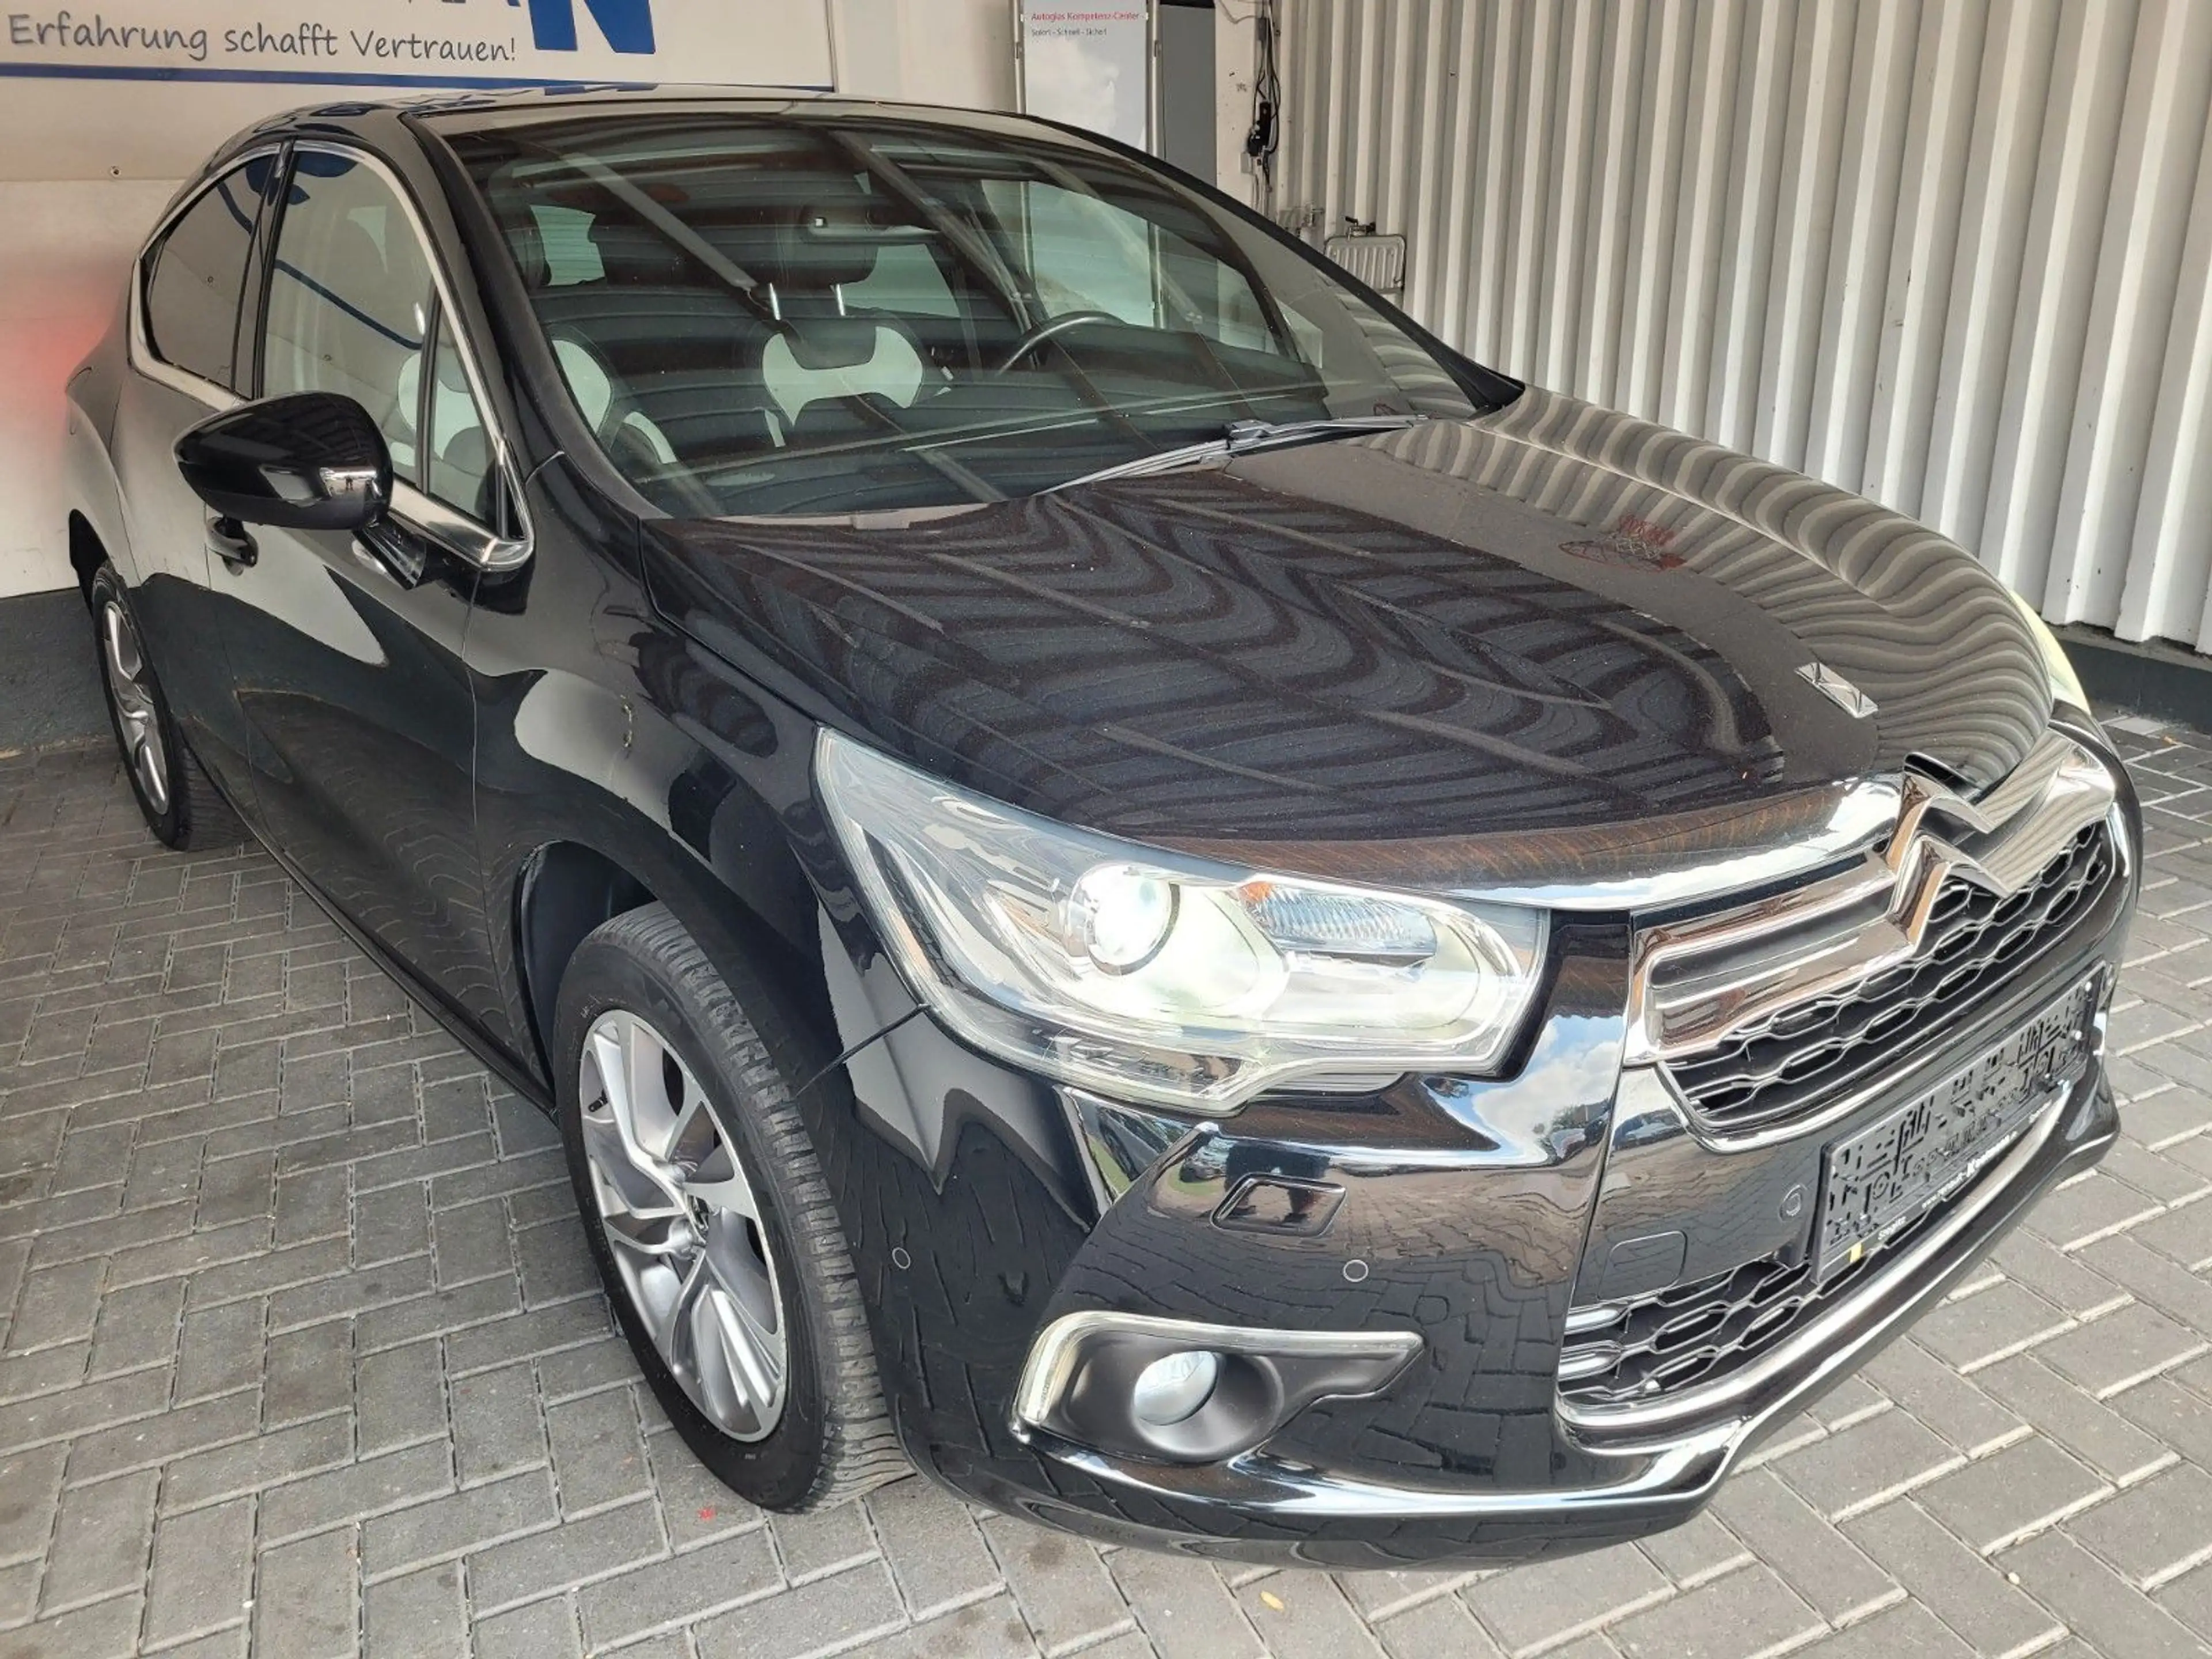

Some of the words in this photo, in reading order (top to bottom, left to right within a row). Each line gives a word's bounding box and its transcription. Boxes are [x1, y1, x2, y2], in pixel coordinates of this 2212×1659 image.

[1031, 12, 1065, 22] Autoglas
[8, 10, 207, 62] Erfahrung
[225, 22, 338, 56] schafft
[350, 30, 516, 62] Vertrauen!
